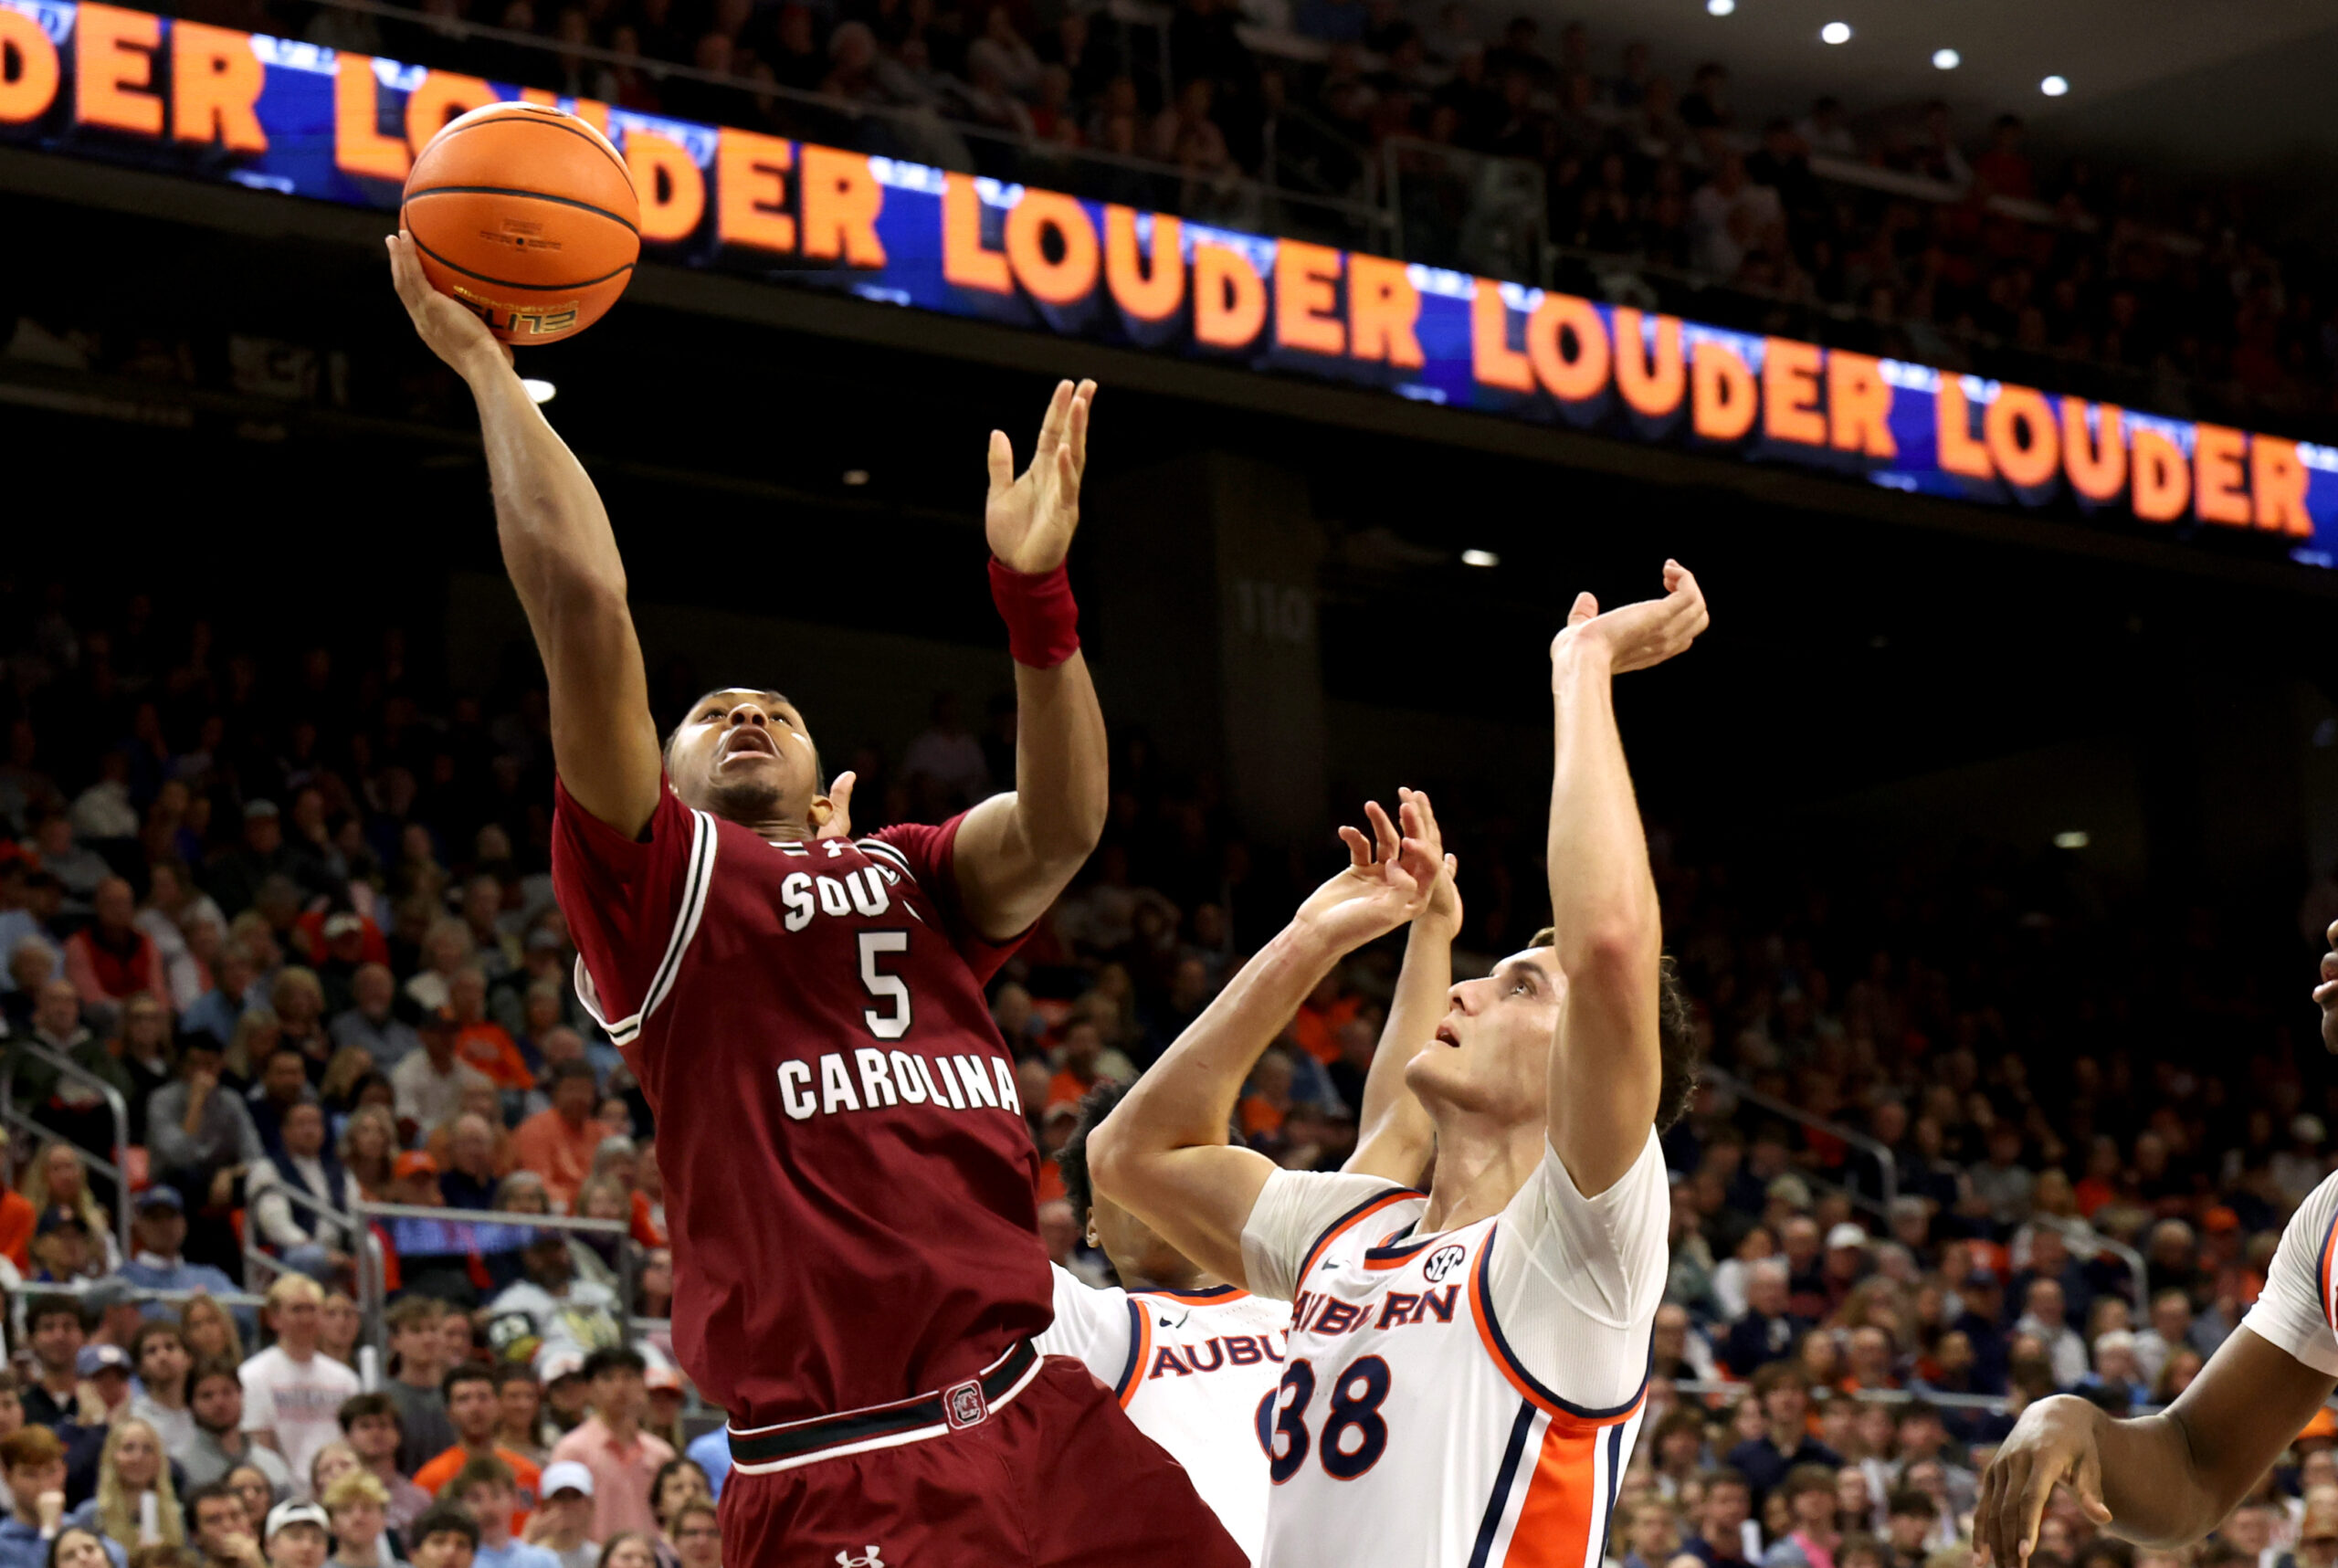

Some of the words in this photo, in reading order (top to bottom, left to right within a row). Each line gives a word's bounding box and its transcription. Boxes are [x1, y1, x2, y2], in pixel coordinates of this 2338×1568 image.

[942, 172, 1424, 369] LOUDER
[1471, 278, 1897, 458] LOUDER
[1935, 371, 2313, 537] LOUDER
[856, 931, 912, 1039] 5
[777, 1047, 1021, 1121] CAROLINA
[1424, 1245, 1465, 1282] SEC
[1270, 1354, 1391, 1486] 38
